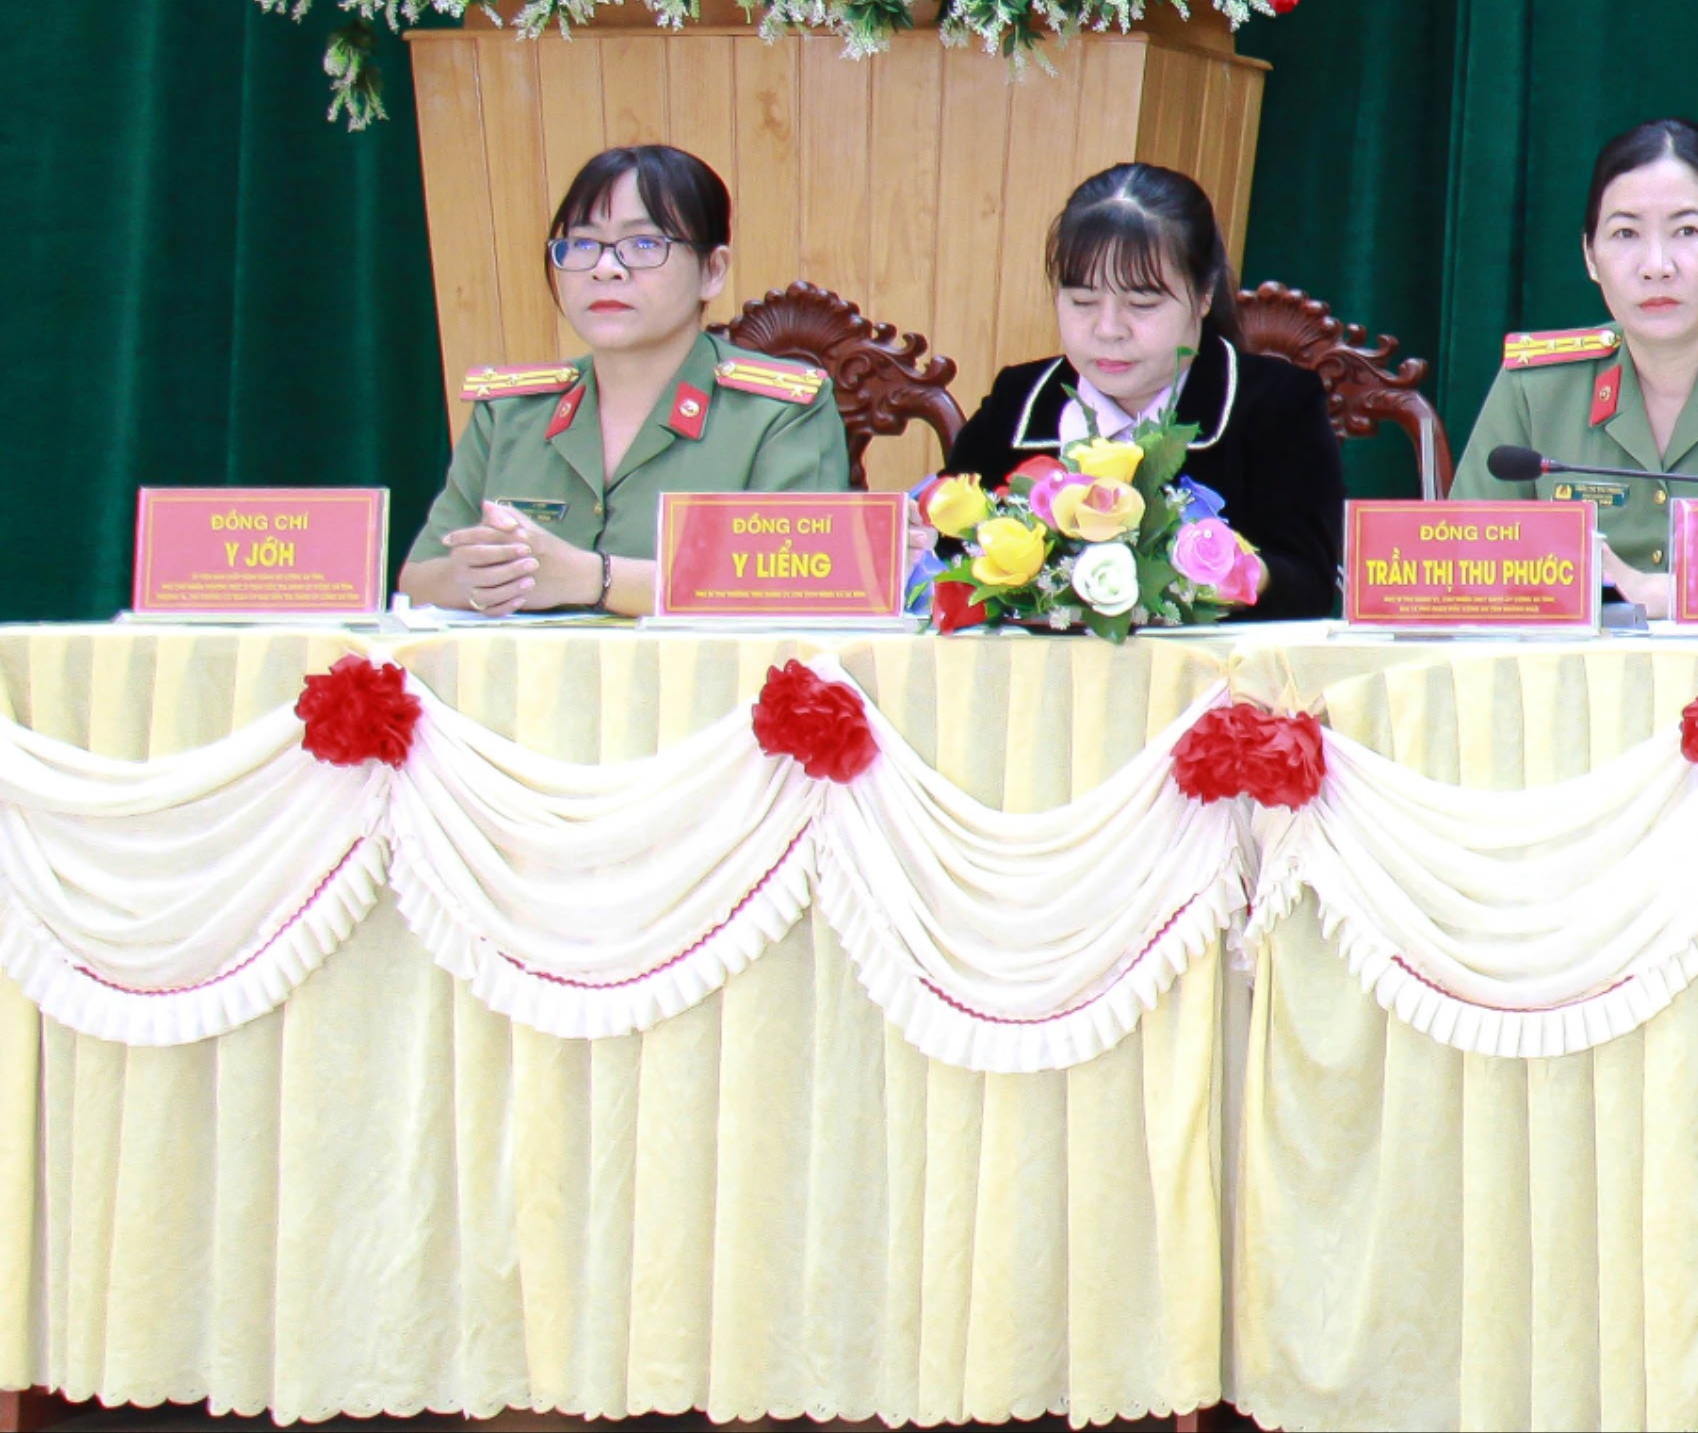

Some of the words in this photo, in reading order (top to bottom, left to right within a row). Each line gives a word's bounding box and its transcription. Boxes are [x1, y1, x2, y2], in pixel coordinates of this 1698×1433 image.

[211, 509, 268, 530] ĐỒNG
[275, 512, 309, 530] CHÍ
[732, 512, 790, 534] ĐỒNG
[797, 515, 831, 533] CHÍ
[1420, 521, 1478, 541] ĐỒNG
[1486, 522, 1520, 541] CHÍ
[225, 542, 240, 567] Y
[732, 553, 748, 578] Y
[757, 540, 831, 578] LIỂNG
[1366, 548, 1417, 585] TRẦN
[1423, 560, 1453, 592] THỊ
[1459, 560, 1496, 585] THU
[1503, 554, 1574, 585] PHƯỚC
